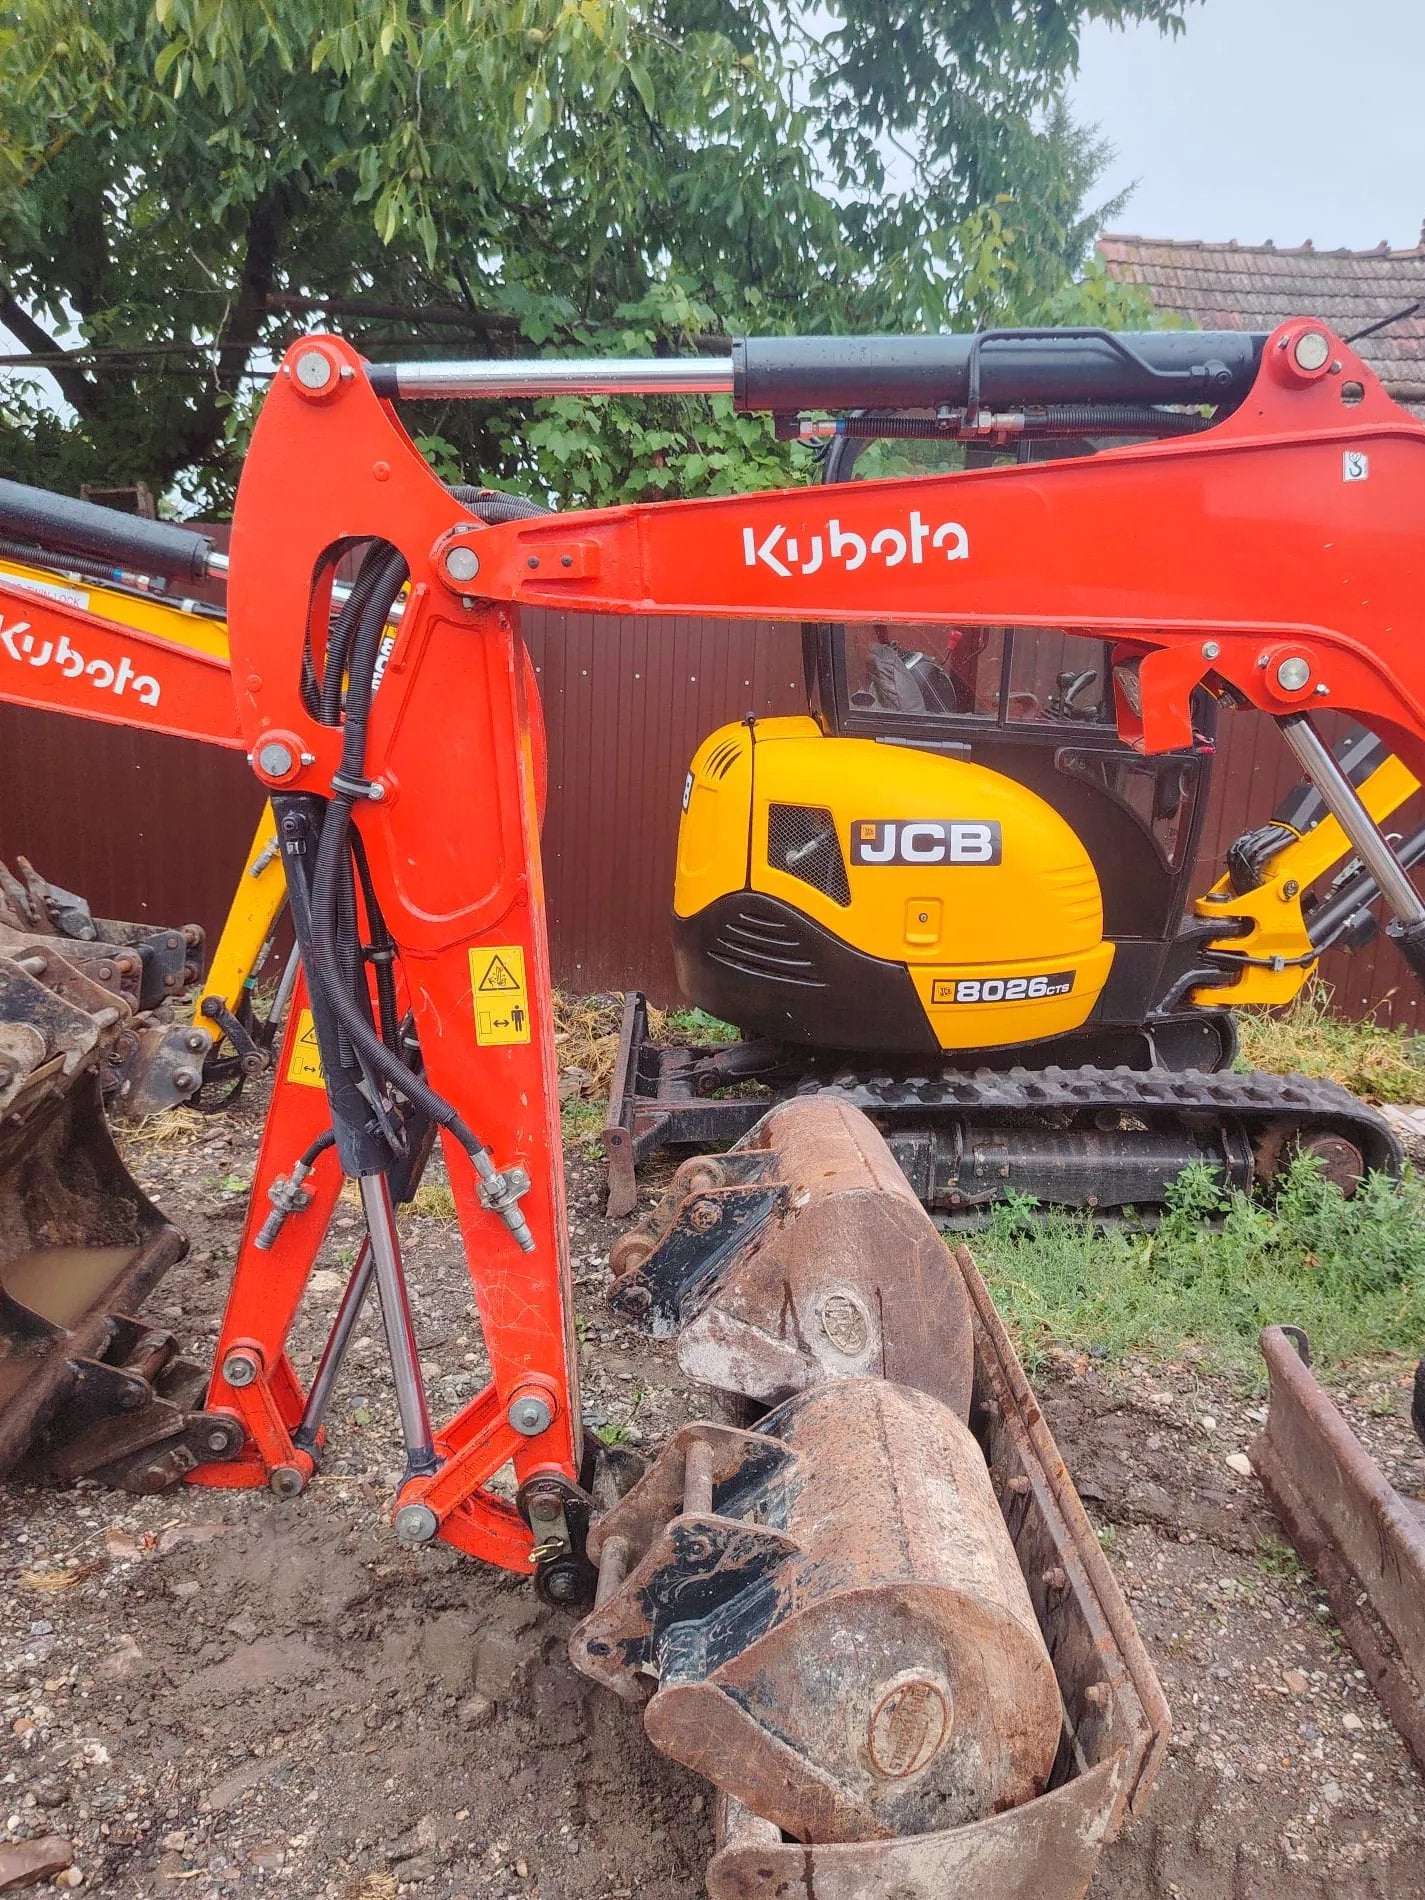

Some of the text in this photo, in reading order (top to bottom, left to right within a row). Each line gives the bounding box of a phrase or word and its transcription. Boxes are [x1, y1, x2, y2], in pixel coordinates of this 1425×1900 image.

[743, 511, 969, 577] Kubota
[0, 614, 161, 706] Kubota
[860, 824, 993, 862] JCB
